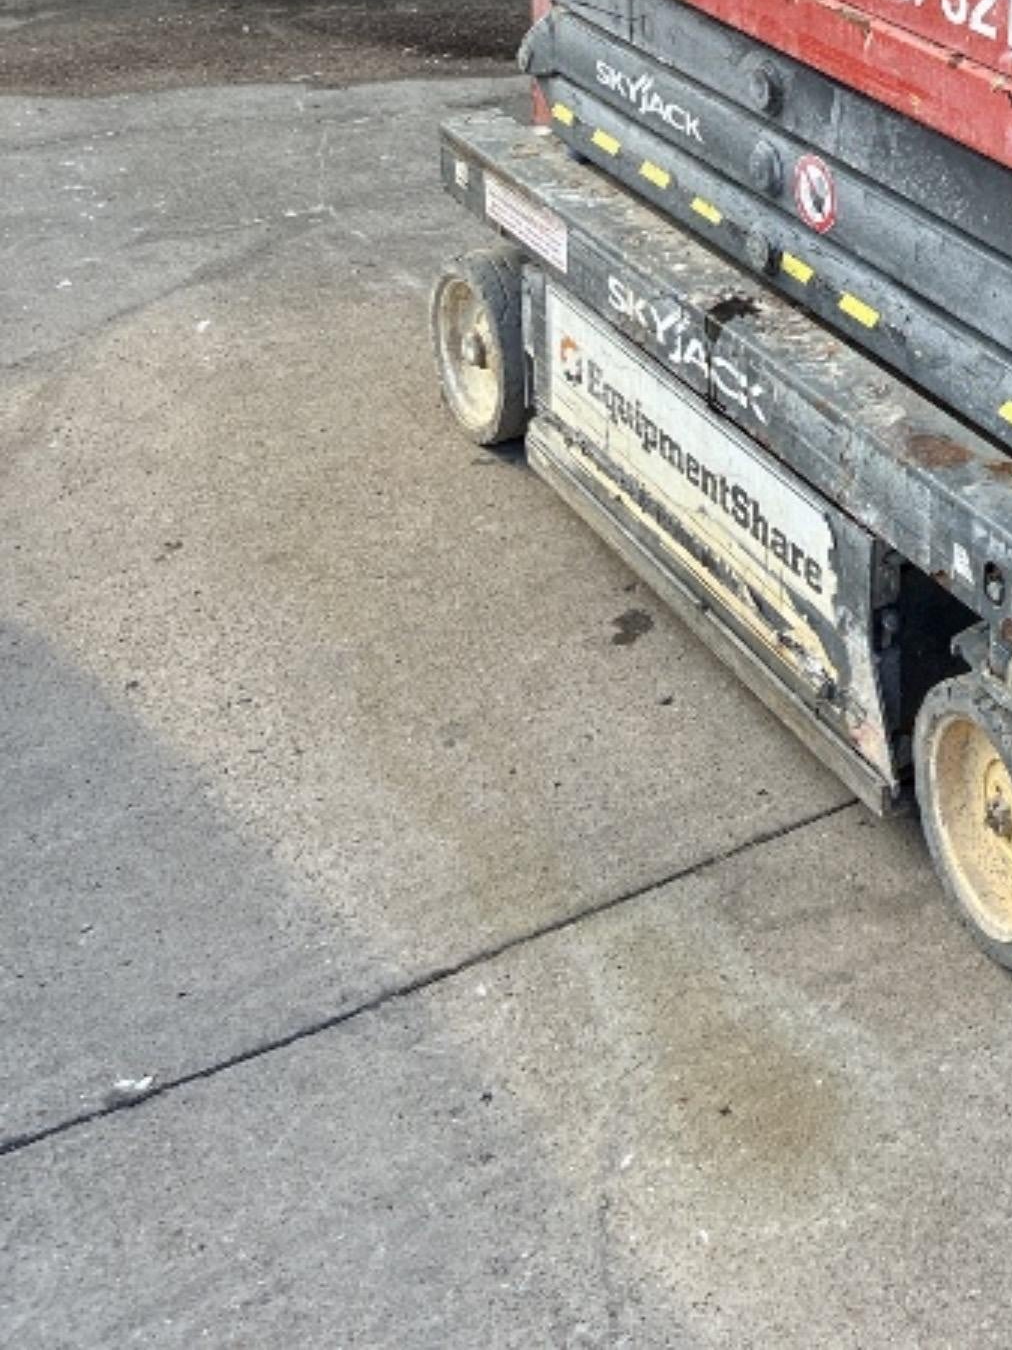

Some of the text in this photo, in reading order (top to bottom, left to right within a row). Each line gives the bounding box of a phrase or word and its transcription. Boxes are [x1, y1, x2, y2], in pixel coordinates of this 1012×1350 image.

[596, 59, 704, 143] SKYJACK
[608, 275, 768, 426] SKYJACK
[587, 358, 824, 594] EquipmentShare
